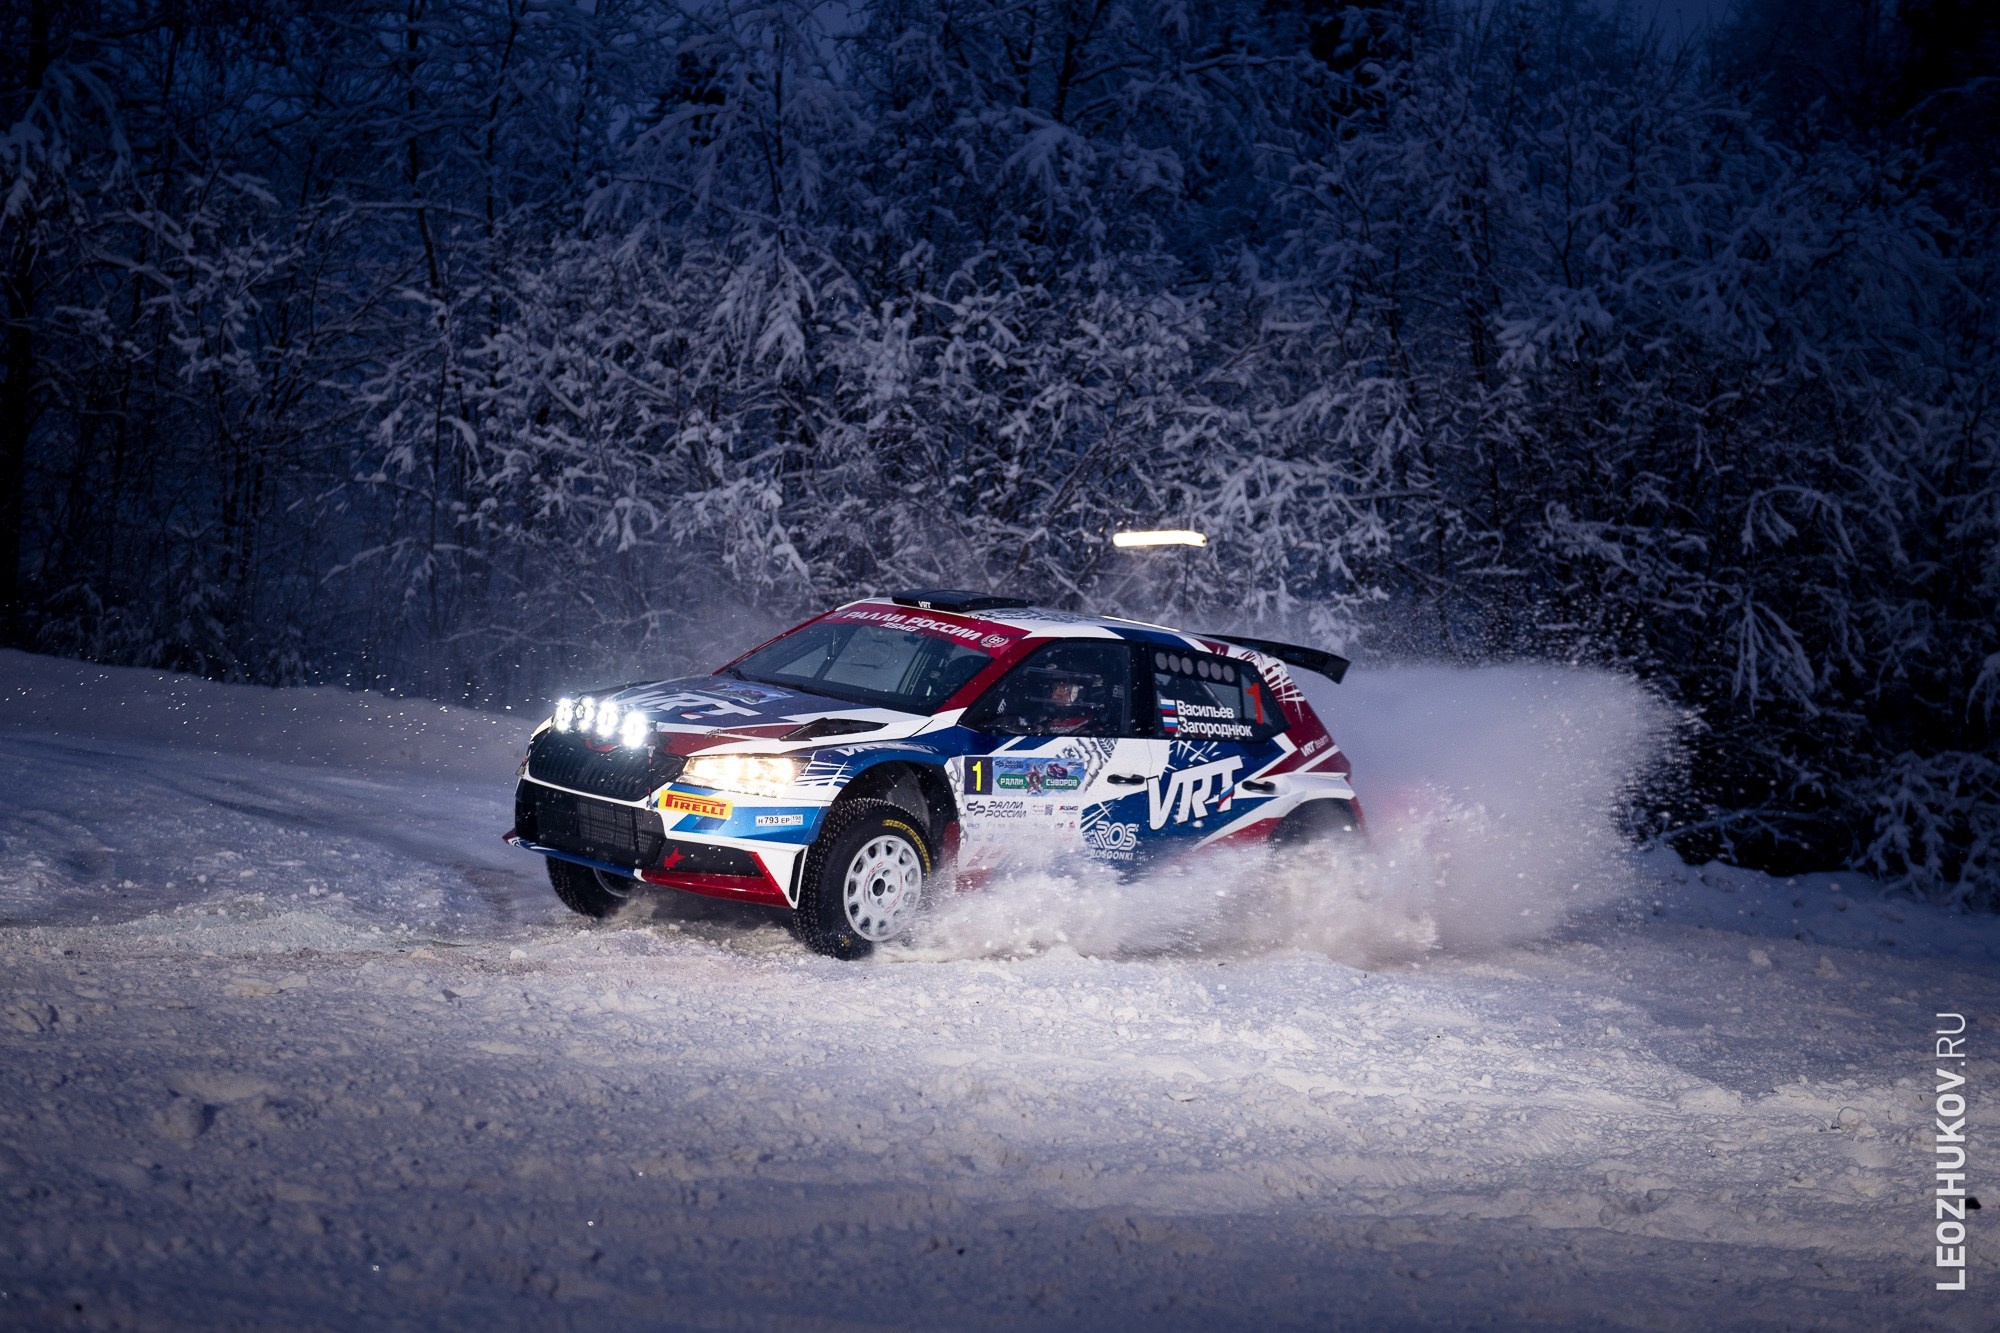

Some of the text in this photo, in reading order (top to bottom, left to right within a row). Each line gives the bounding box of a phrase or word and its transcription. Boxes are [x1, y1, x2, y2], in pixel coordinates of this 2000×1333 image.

[918, 600, 932, 609] VRT
[842, 610, 908, 623] РАЛЛИ
[904, 616, 983, 641] РОССИИ
[1176, 699, 1235, 719] Васильев
[1246, 682, 1264, 724] 1
[1178, 716, 1254, 738] Загороднюк
[972, 760, 982, 792] 1
[1000, 778, 1078, 787] РАЛЛИ СУВОРОВ
[1146, 754, 1244, 831] VRT
[665, 793, 727, 816] PIRELLI
[984, 809, 1027, 818] РОССИИ
[988, 800, 1024, 809] РАЛЛИ
[1089, 820, 1140, 851] ROS
